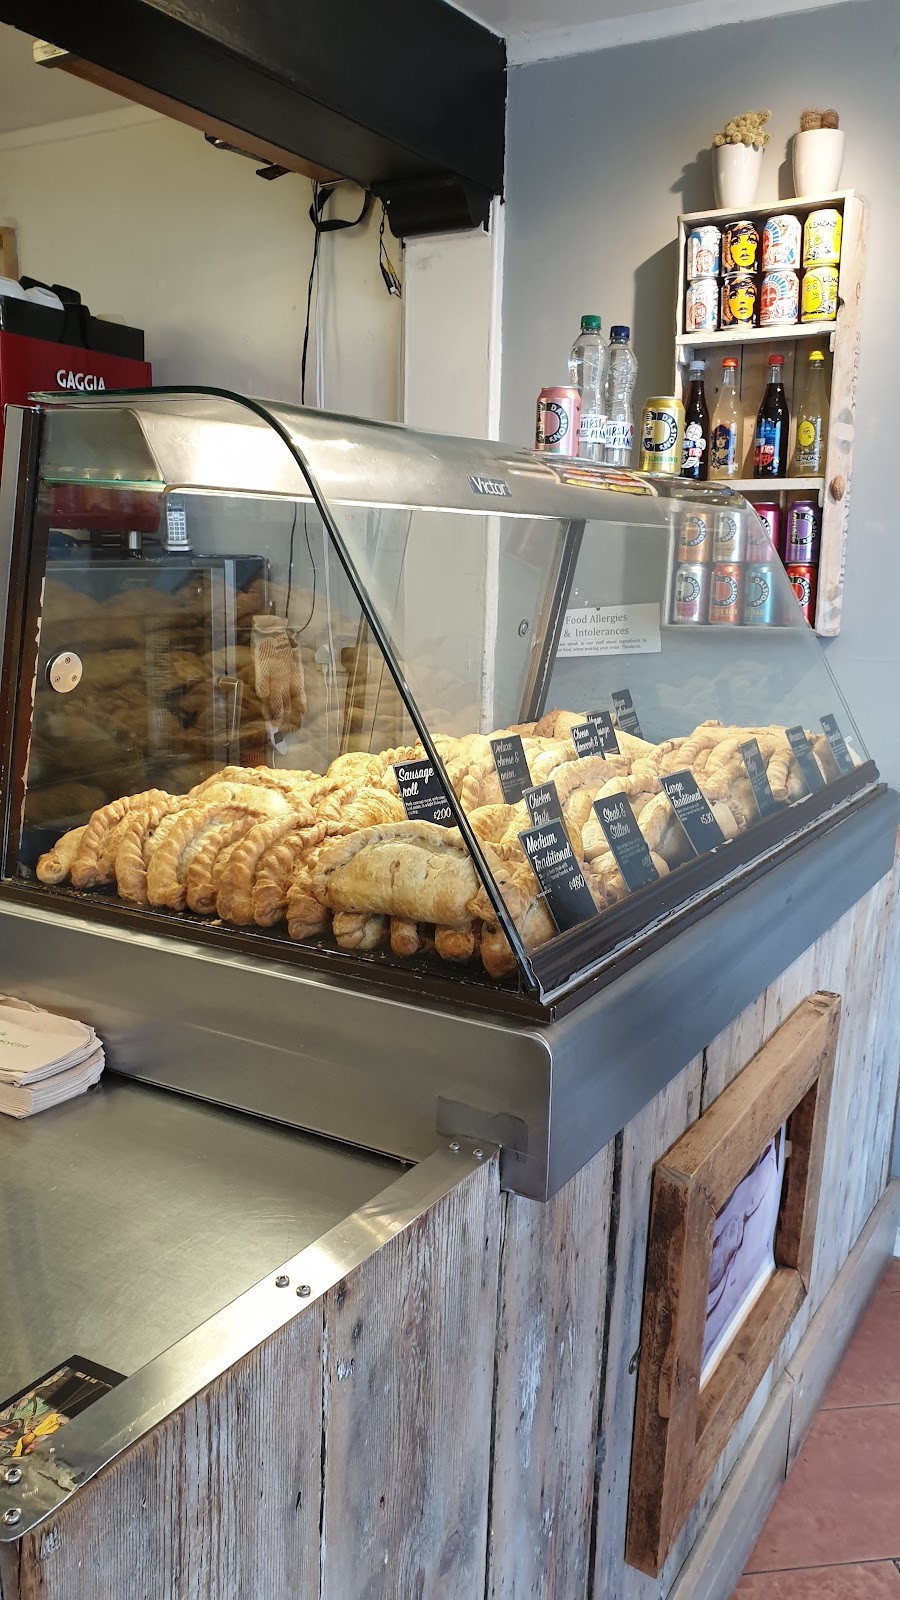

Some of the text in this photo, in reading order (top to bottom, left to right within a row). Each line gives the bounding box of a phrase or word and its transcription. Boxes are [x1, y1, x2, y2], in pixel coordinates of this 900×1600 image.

[56, 369, 106, 390] GAGGIA
[471, 476, 506, 496] Victor
[565, 613, 628, 625] Food Allergies
[563, 627, 629, 638] & Intolerances
[573, 727, 589, 740] Cheese
[514, 751, 520, 763] &
[398, 767, 435, 784] Sausage
[402, 781, 419, 798] roll
[665, 782, 685, 798] Large
[671, 787, 703, 809] Traditional
[529, 789, 552, 809] Chicken
[603, 802, 627, 823] Steak &
[609, 822, 631, 840] Stilton
[526, 832, 558, 855] Medium
[532, 841, 573, 872] Traditional
